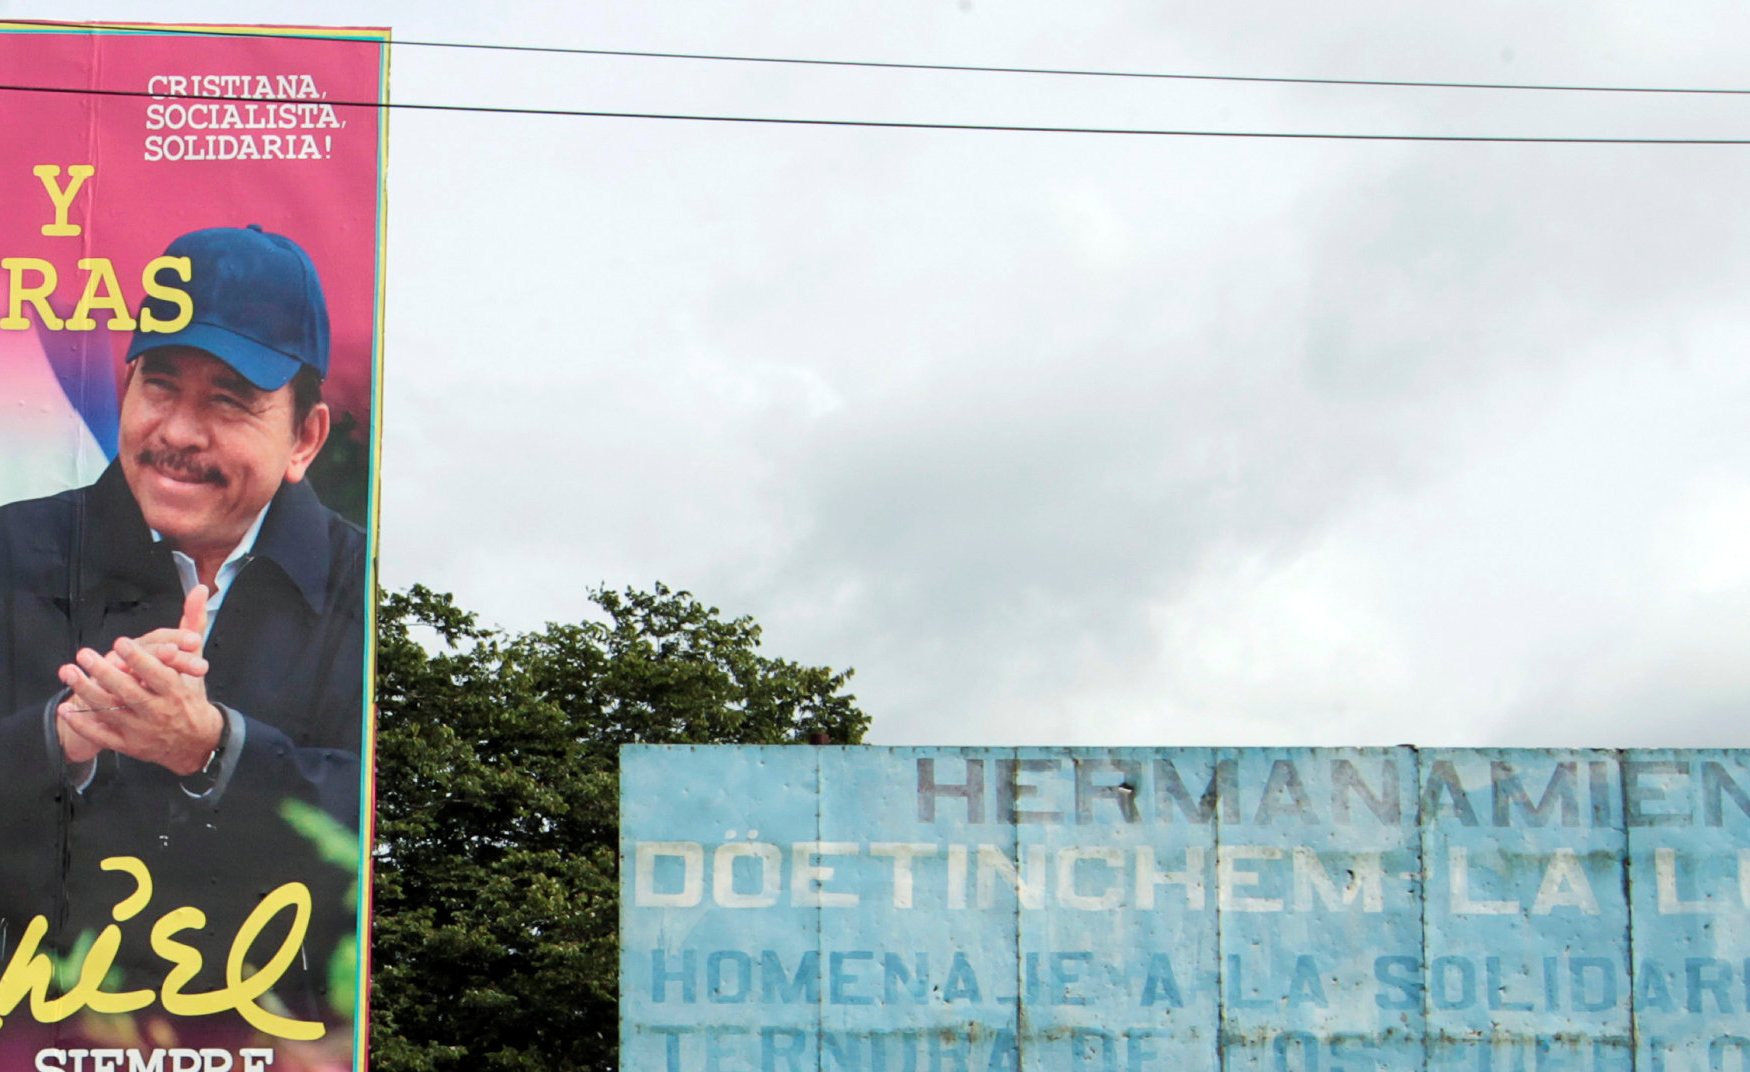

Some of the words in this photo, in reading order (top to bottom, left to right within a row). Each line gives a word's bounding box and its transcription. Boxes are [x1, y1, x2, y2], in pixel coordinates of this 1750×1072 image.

[147, 75, 327, 100] CRISTIANA,
[146, 104, 347, 131] SOCIALISTA,
[144, 135, 333, 161] SOLIDARIA!
[32, 164, 95, 237] Y
[915, 757, 1750, 829] HERMANAMIEN
[650, 949, 1093, 1007] HOMENAJE
[1227, 953, 1329, 1010] LA
